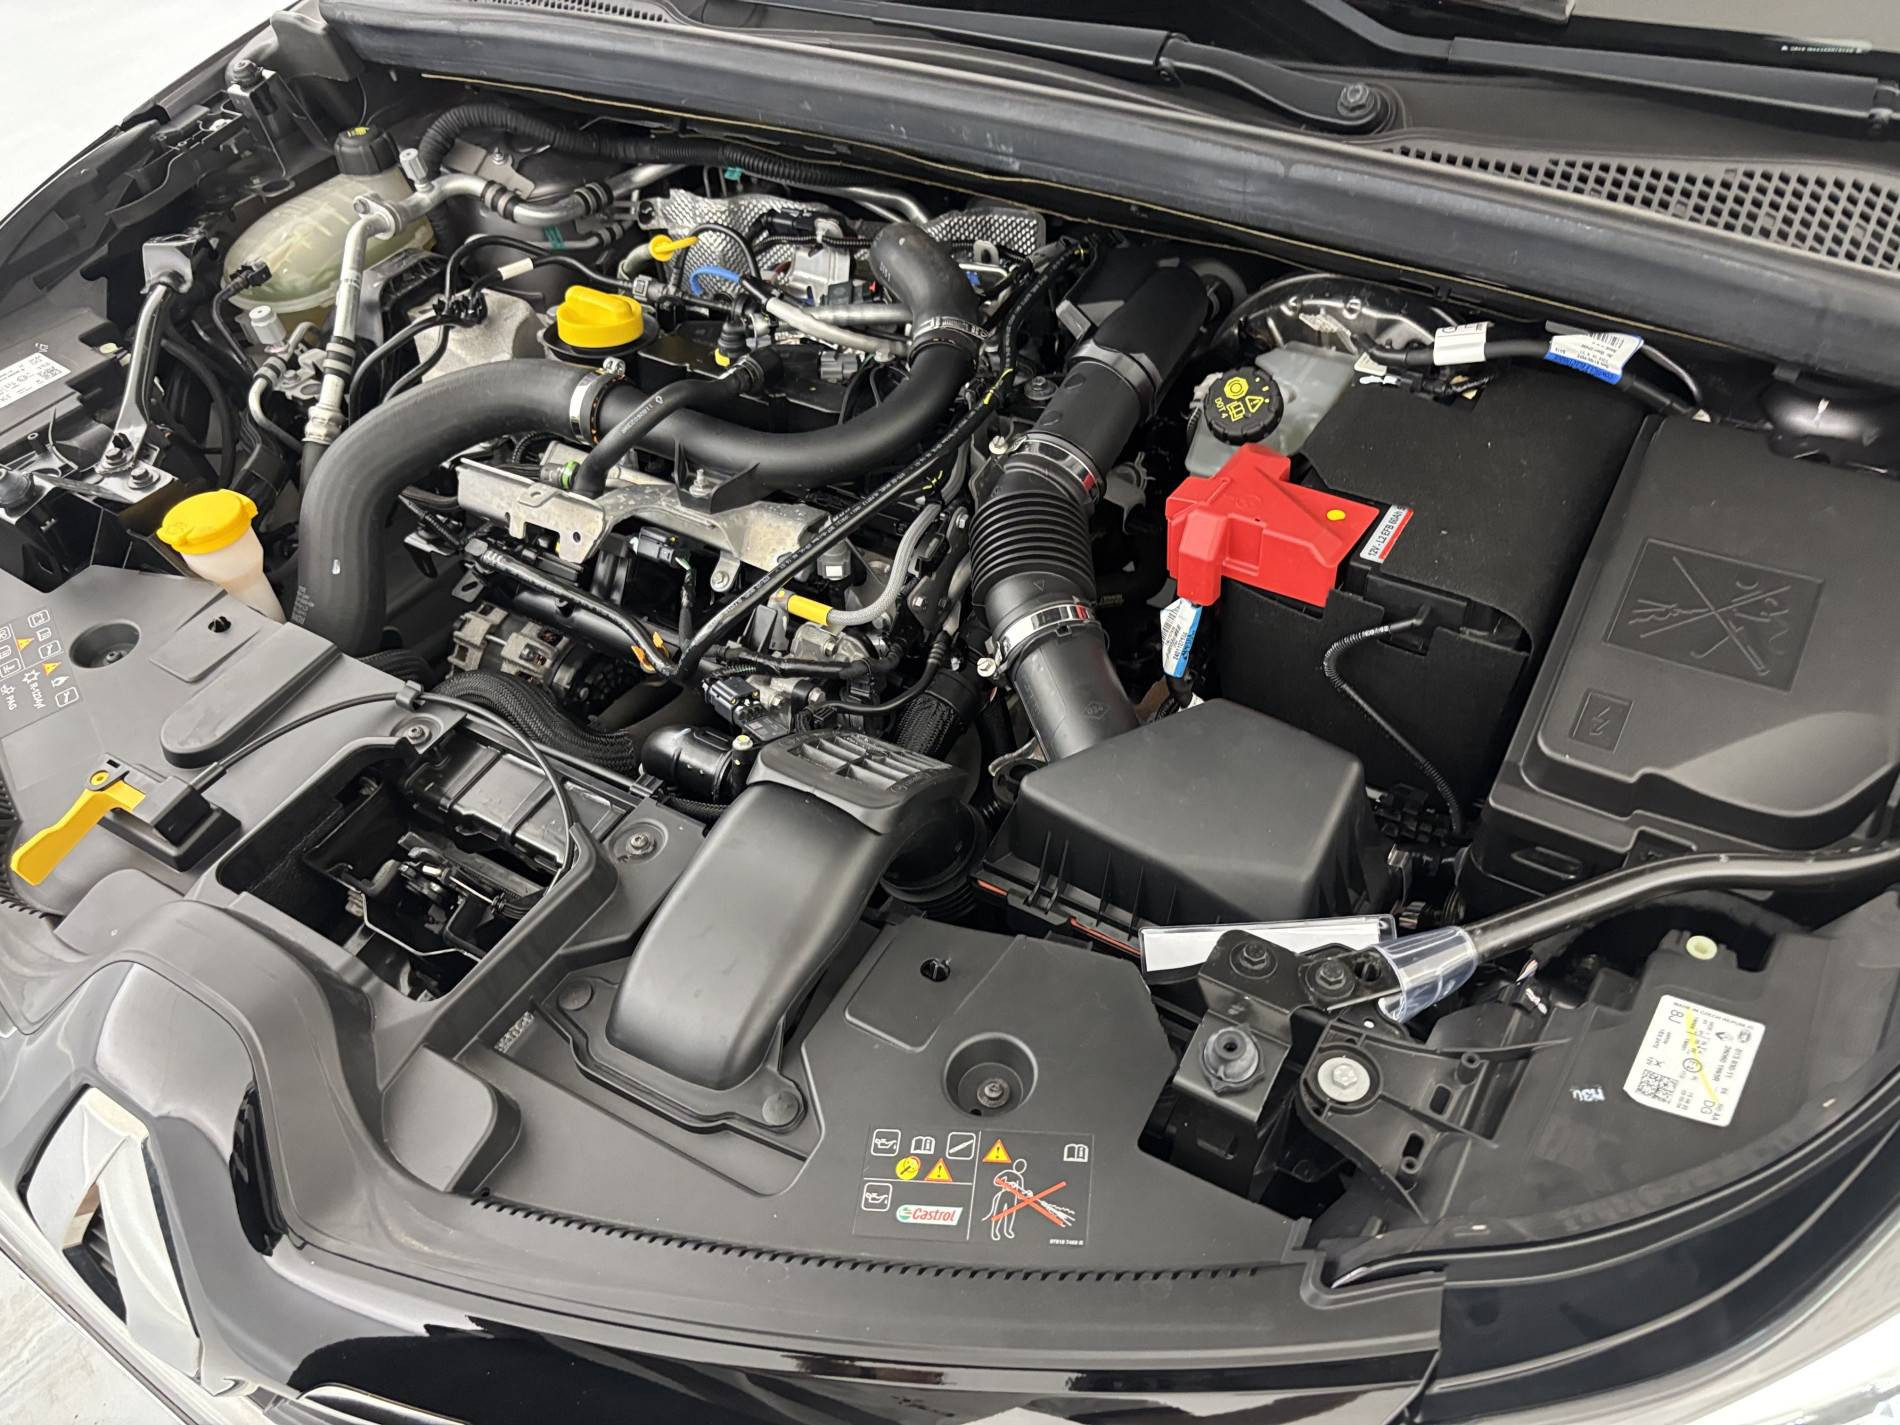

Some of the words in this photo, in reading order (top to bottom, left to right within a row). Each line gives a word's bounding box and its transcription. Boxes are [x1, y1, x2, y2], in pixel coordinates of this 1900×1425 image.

[1214, 396, 1226, 411] DOT
[1380, 522, 1394, 537] EFB
[1375, 533, 1386, 544] L2
[1367, 544, 1380, 558] 12V
[6, 695, 17, 711] PAG
[1668, 1009, 1685, 1025] 8J
[1701, 1100, 1716, 1114] DG
[910, 1207, 956, 1222] Castrol
